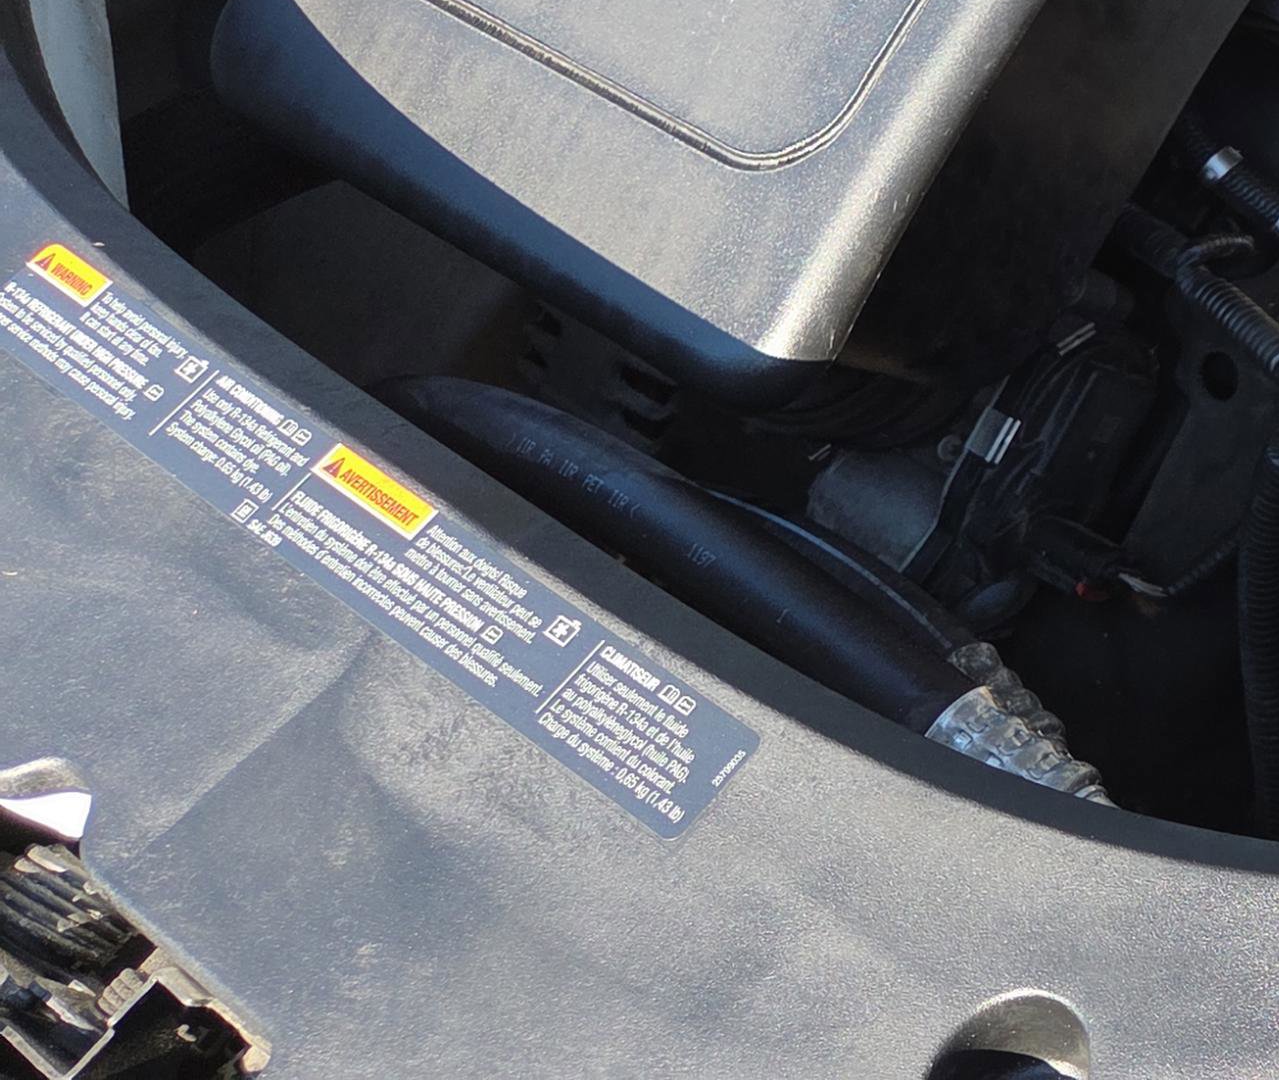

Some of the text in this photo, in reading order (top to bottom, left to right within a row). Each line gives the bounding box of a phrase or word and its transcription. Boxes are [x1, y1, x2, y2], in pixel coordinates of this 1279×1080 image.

[49, 261, 93, 296] WARNING
[6, 320, 36, 343] service
[27, 336, 61, 362] methods
[66, 366, 92, 387] cause
[83, 378, 120, 407] personal
[25, 296, 77, 336] REFRIGERANT
[107, 356, 150, 389] PRESSURE
[29, 318, 62, 344] serviced
[135, 318, 172, 348] personal
[186, 398, 236, 436] Polyalkylene
[200, 386, 310, 468] Use only R-134a Refrigerant and
[213, 373, 285, 426] AIR CONDITIONING
[226, 426, 257, 451] Glycol
[163, 420, 198, 448] System
[212, 456, 237, 476] 0.65
[237, 474, 264, 497] (1.43
[255, 487, 274, 504] lb)
[176, 408, 263, 476] The system contains dye.
[248, 441, 265, 455] oil
[256, 447, 282, 469] (PAG
[245, 517, 267, 536] SAE
[336, 467, 420, 528] AVERTISSEMENT
[277, 501, 322, 535] L'entretien
[321, 534, 360, 565] système
[351, 554, 375, 574] doit
[366, 564, 390, 585] être
[381, 575, 419, 605] effectué
[409, 599, 429, 617] par
[432, 615, 476, 650] personnel
[468, 640, 505, 670] qualifié
[496, 659, 545, 698] seulement.
[288, 489, 324, 518] FLUIDE
[363, 541, 400, 571] R-134a
[391, 561, 421, 586] SOUS
[412, 577, 447, 605] HAUTE
[437, 596, 485, 633] PRESSION
[402, 546, 434, 571] mettre
[433, 567, 468, 595] tourner
[459, 587, 484, 608] sans
[478, 599, 538, 644] avertissement.
[424, 523, 465, 555] Attention
[457, 547, 478, 564] aux
[495, 572, 530, 601] Risque
[470, 574, 516, 609] ventilateur
[508, 601, 534, 623] peut
[266, 513, 502, 688] Des méthodes d'entretien incorrectes peuvent causer des blessures.
[584, 659, 619, 688] Utiliser
[611, 678, 660, 717] seulement
[661, 713, 692, 739] fluide
[598, 644, 662, 693] CLIMATISEUR
[557, 705, 600, 741] système
[592, 729, 632, 762] contient
[635, 760, 678, 796] colorant.
[570, 672, 622, 713] frigorigène
[613, 701, 651, 732] R-134a
[664, 737, 697, 765] l'huile
[570, 693, 648, 754] polyalkylèneglycol
[640, 742, 671, 769] (huile
[662, 758, 693, 785] PAG).
[535, 710, 572, 742] Charge
[574, 739, 617, 775] système
[613, 766, 641, 791] 0,65
[644, 788, 675, 816] (1,43
[666, 804, 686, 824] lb)
